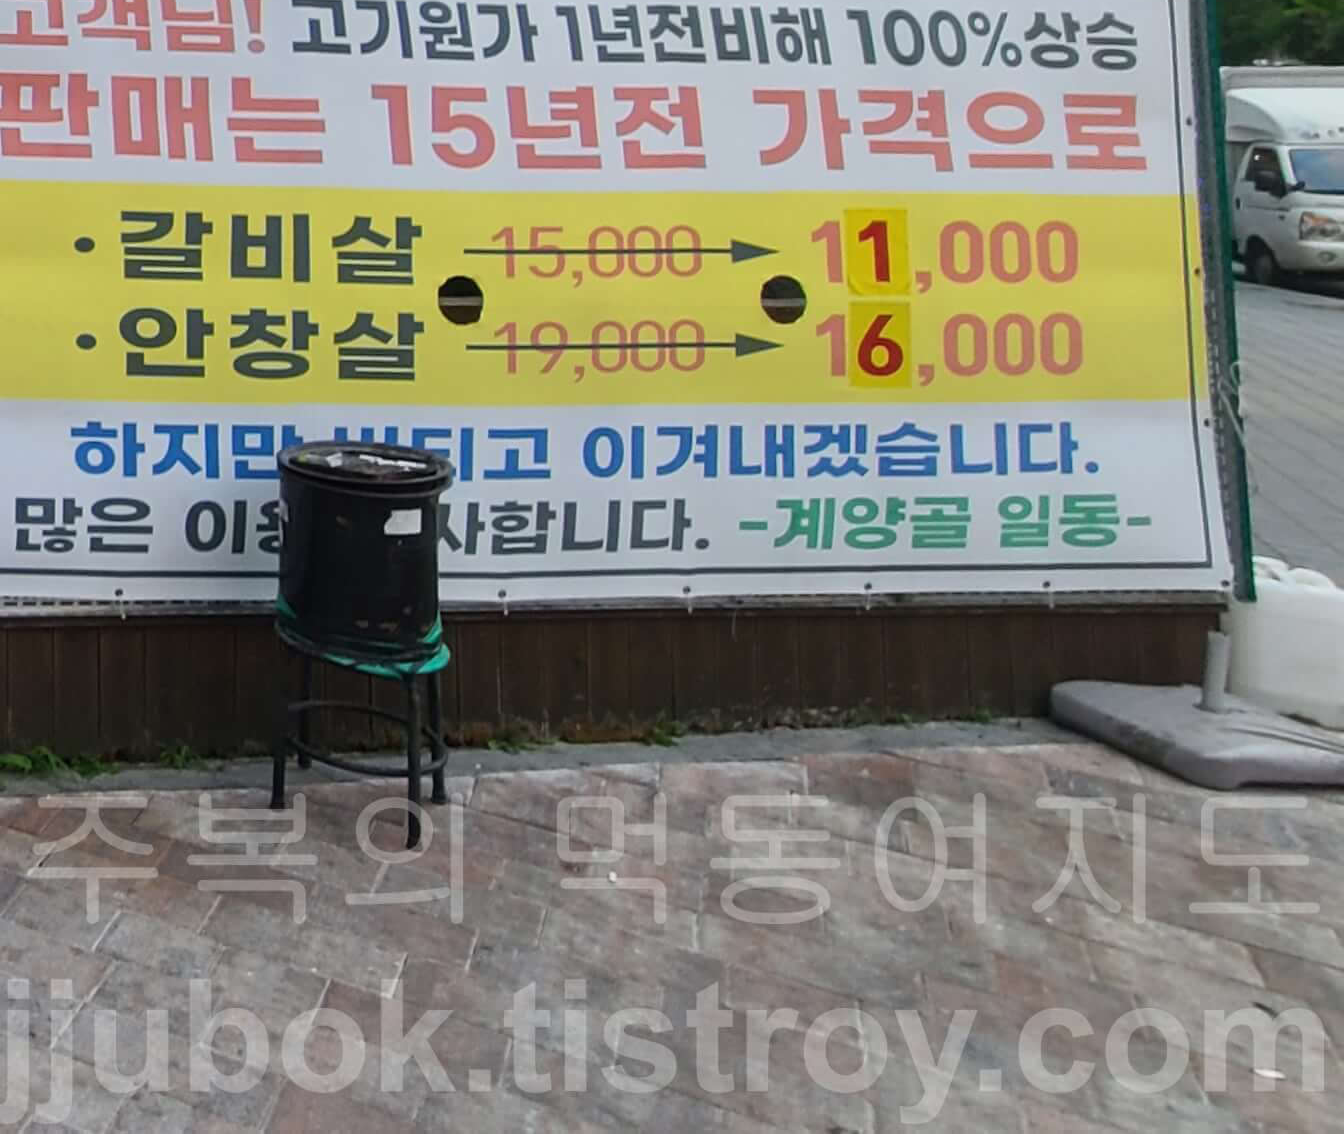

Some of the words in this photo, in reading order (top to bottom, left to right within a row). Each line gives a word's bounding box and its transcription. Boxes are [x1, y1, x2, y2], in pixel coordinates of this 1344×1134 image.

[556, 3, 833, 66] 1년전비해
[847, 8, 1140, 70] 100%상승
[370, 84, 707, 171] 15년전
[751, 87, 1149, 173] 가격으로
[119, 210, 424, 286] 갈비살
[490, 224, 704, 289] 15,000
[811, 218, 1080, 294] 11,000
[118, 307, 426, 383] 안창살
[492, 317, 706, 384] 19,000
[814, 310, 1084, 388] 16,000
[69, 420, 305, 482] 하지만
[581, 419, 1100, 480] 이겨내겠습니다.
[13, 496, 154, 556] 많은
[438, 497, 711, 556] 사합니다.
[738, 495, 972, 551] -계양골
[996, 491, 1152, 550] 일동-
